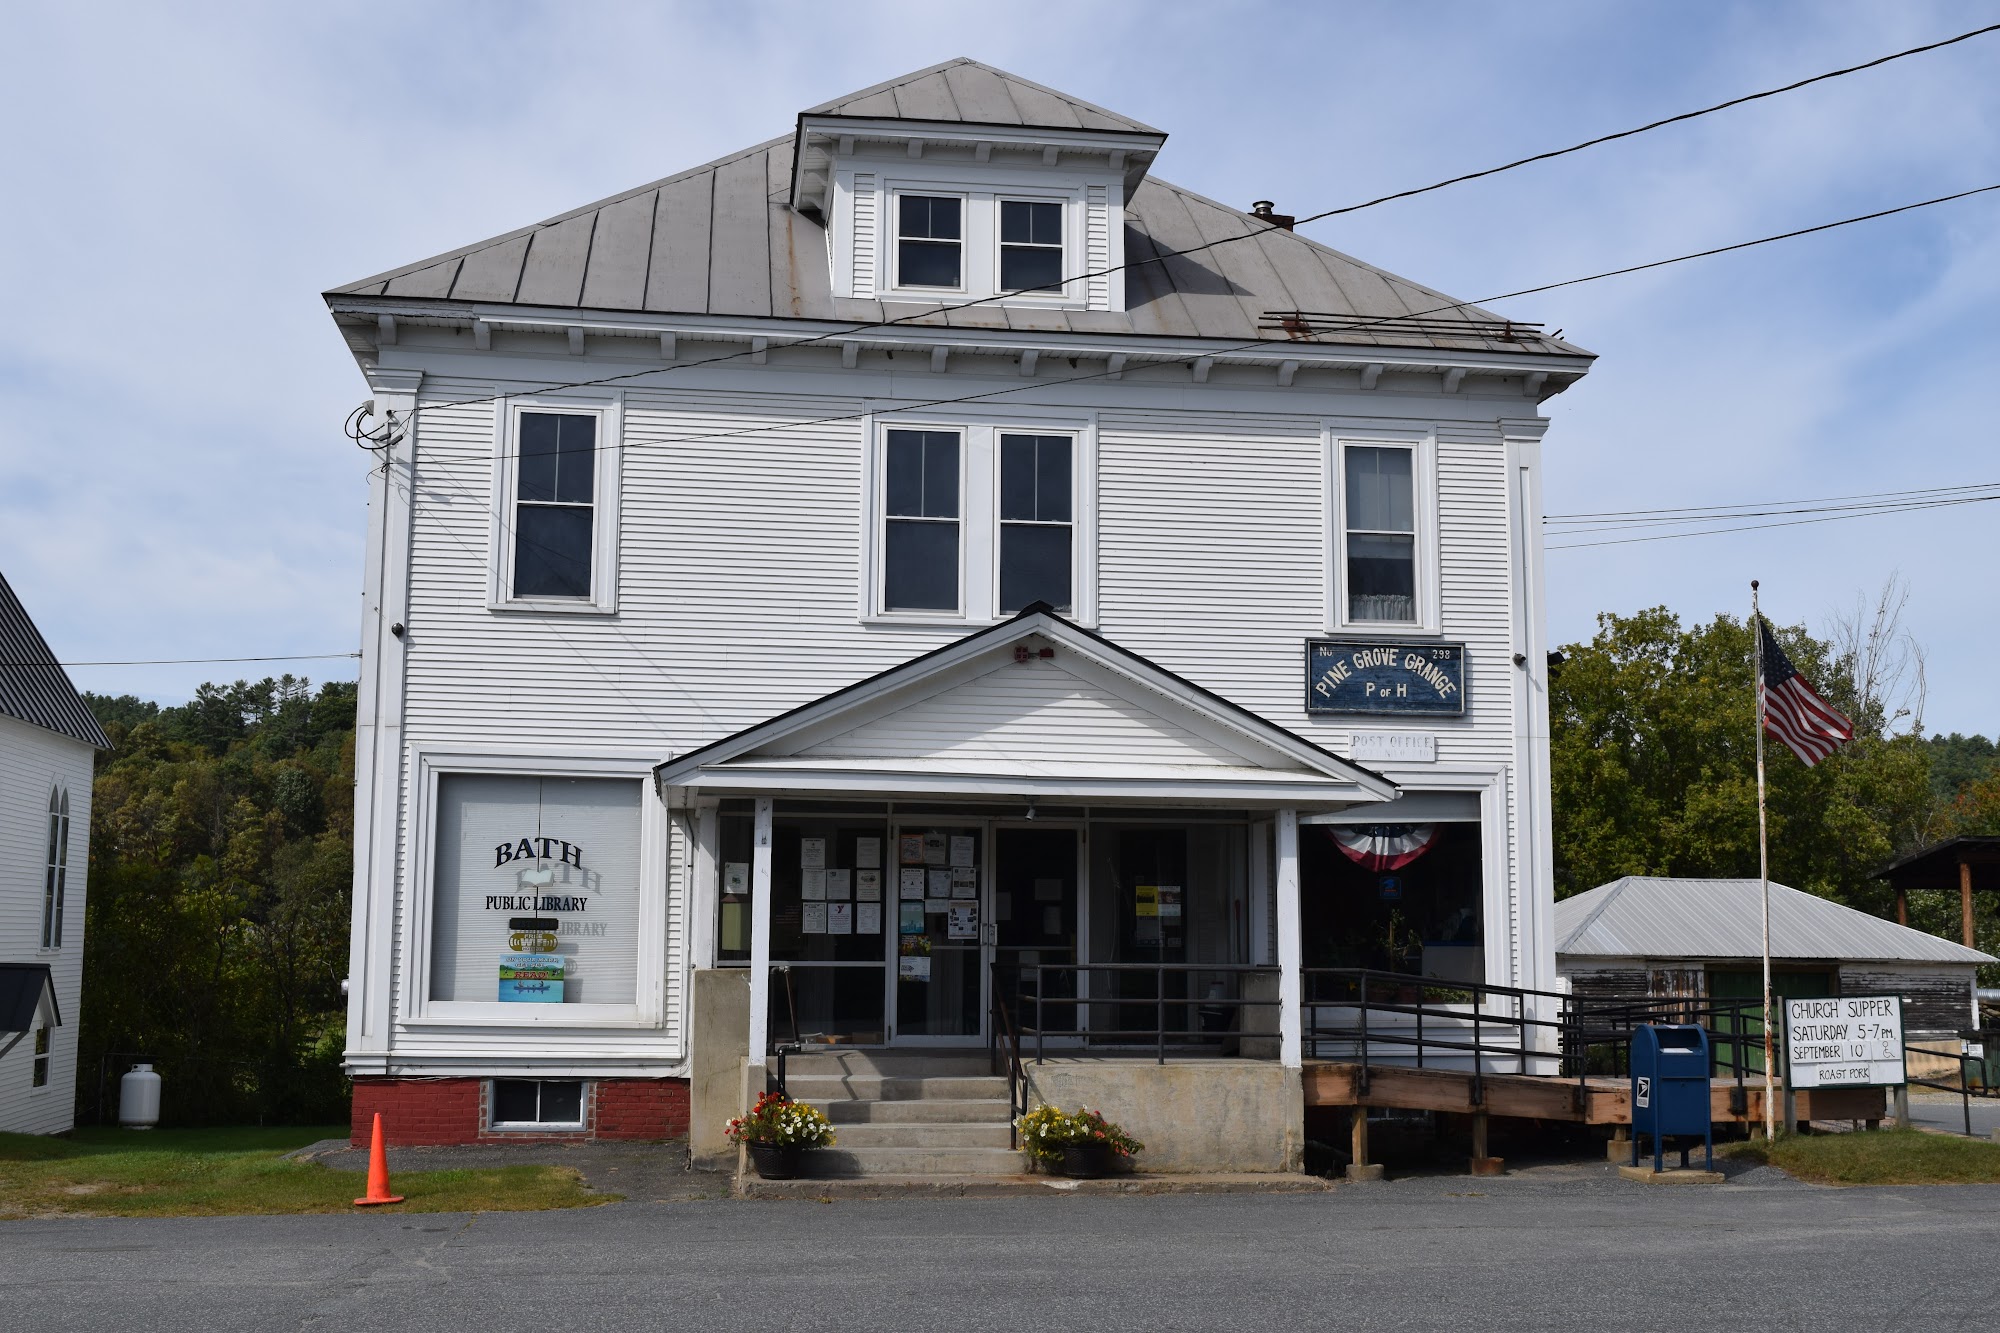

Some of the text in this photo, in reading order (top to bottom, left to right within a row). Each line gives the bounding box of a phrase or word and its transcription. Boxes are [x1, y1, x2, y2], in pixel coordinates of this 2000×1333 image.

[1432, 649, 1451, 660] 298
[1315, 648, 1457, 699] PINE GROVE GRANGE
[1365, 682, 1407, 698] P OF H
[1352, 735, 1431, 748] POST OFFICE
[494, 837, 583, 871] BATH
[485, 895, 588, 912] PUBLIC LIBRARY
[514, 971, 549, 979] READ!
[1791, 999, 1893, 1019] CHURCH SUPPER
[1793, 1024, 1848, 1041] SATURDAY
[1793, 1044, 1864, 1060] SEPTEMBER 10
[1819, 1068, 1870, 1080] ROAST PORK
